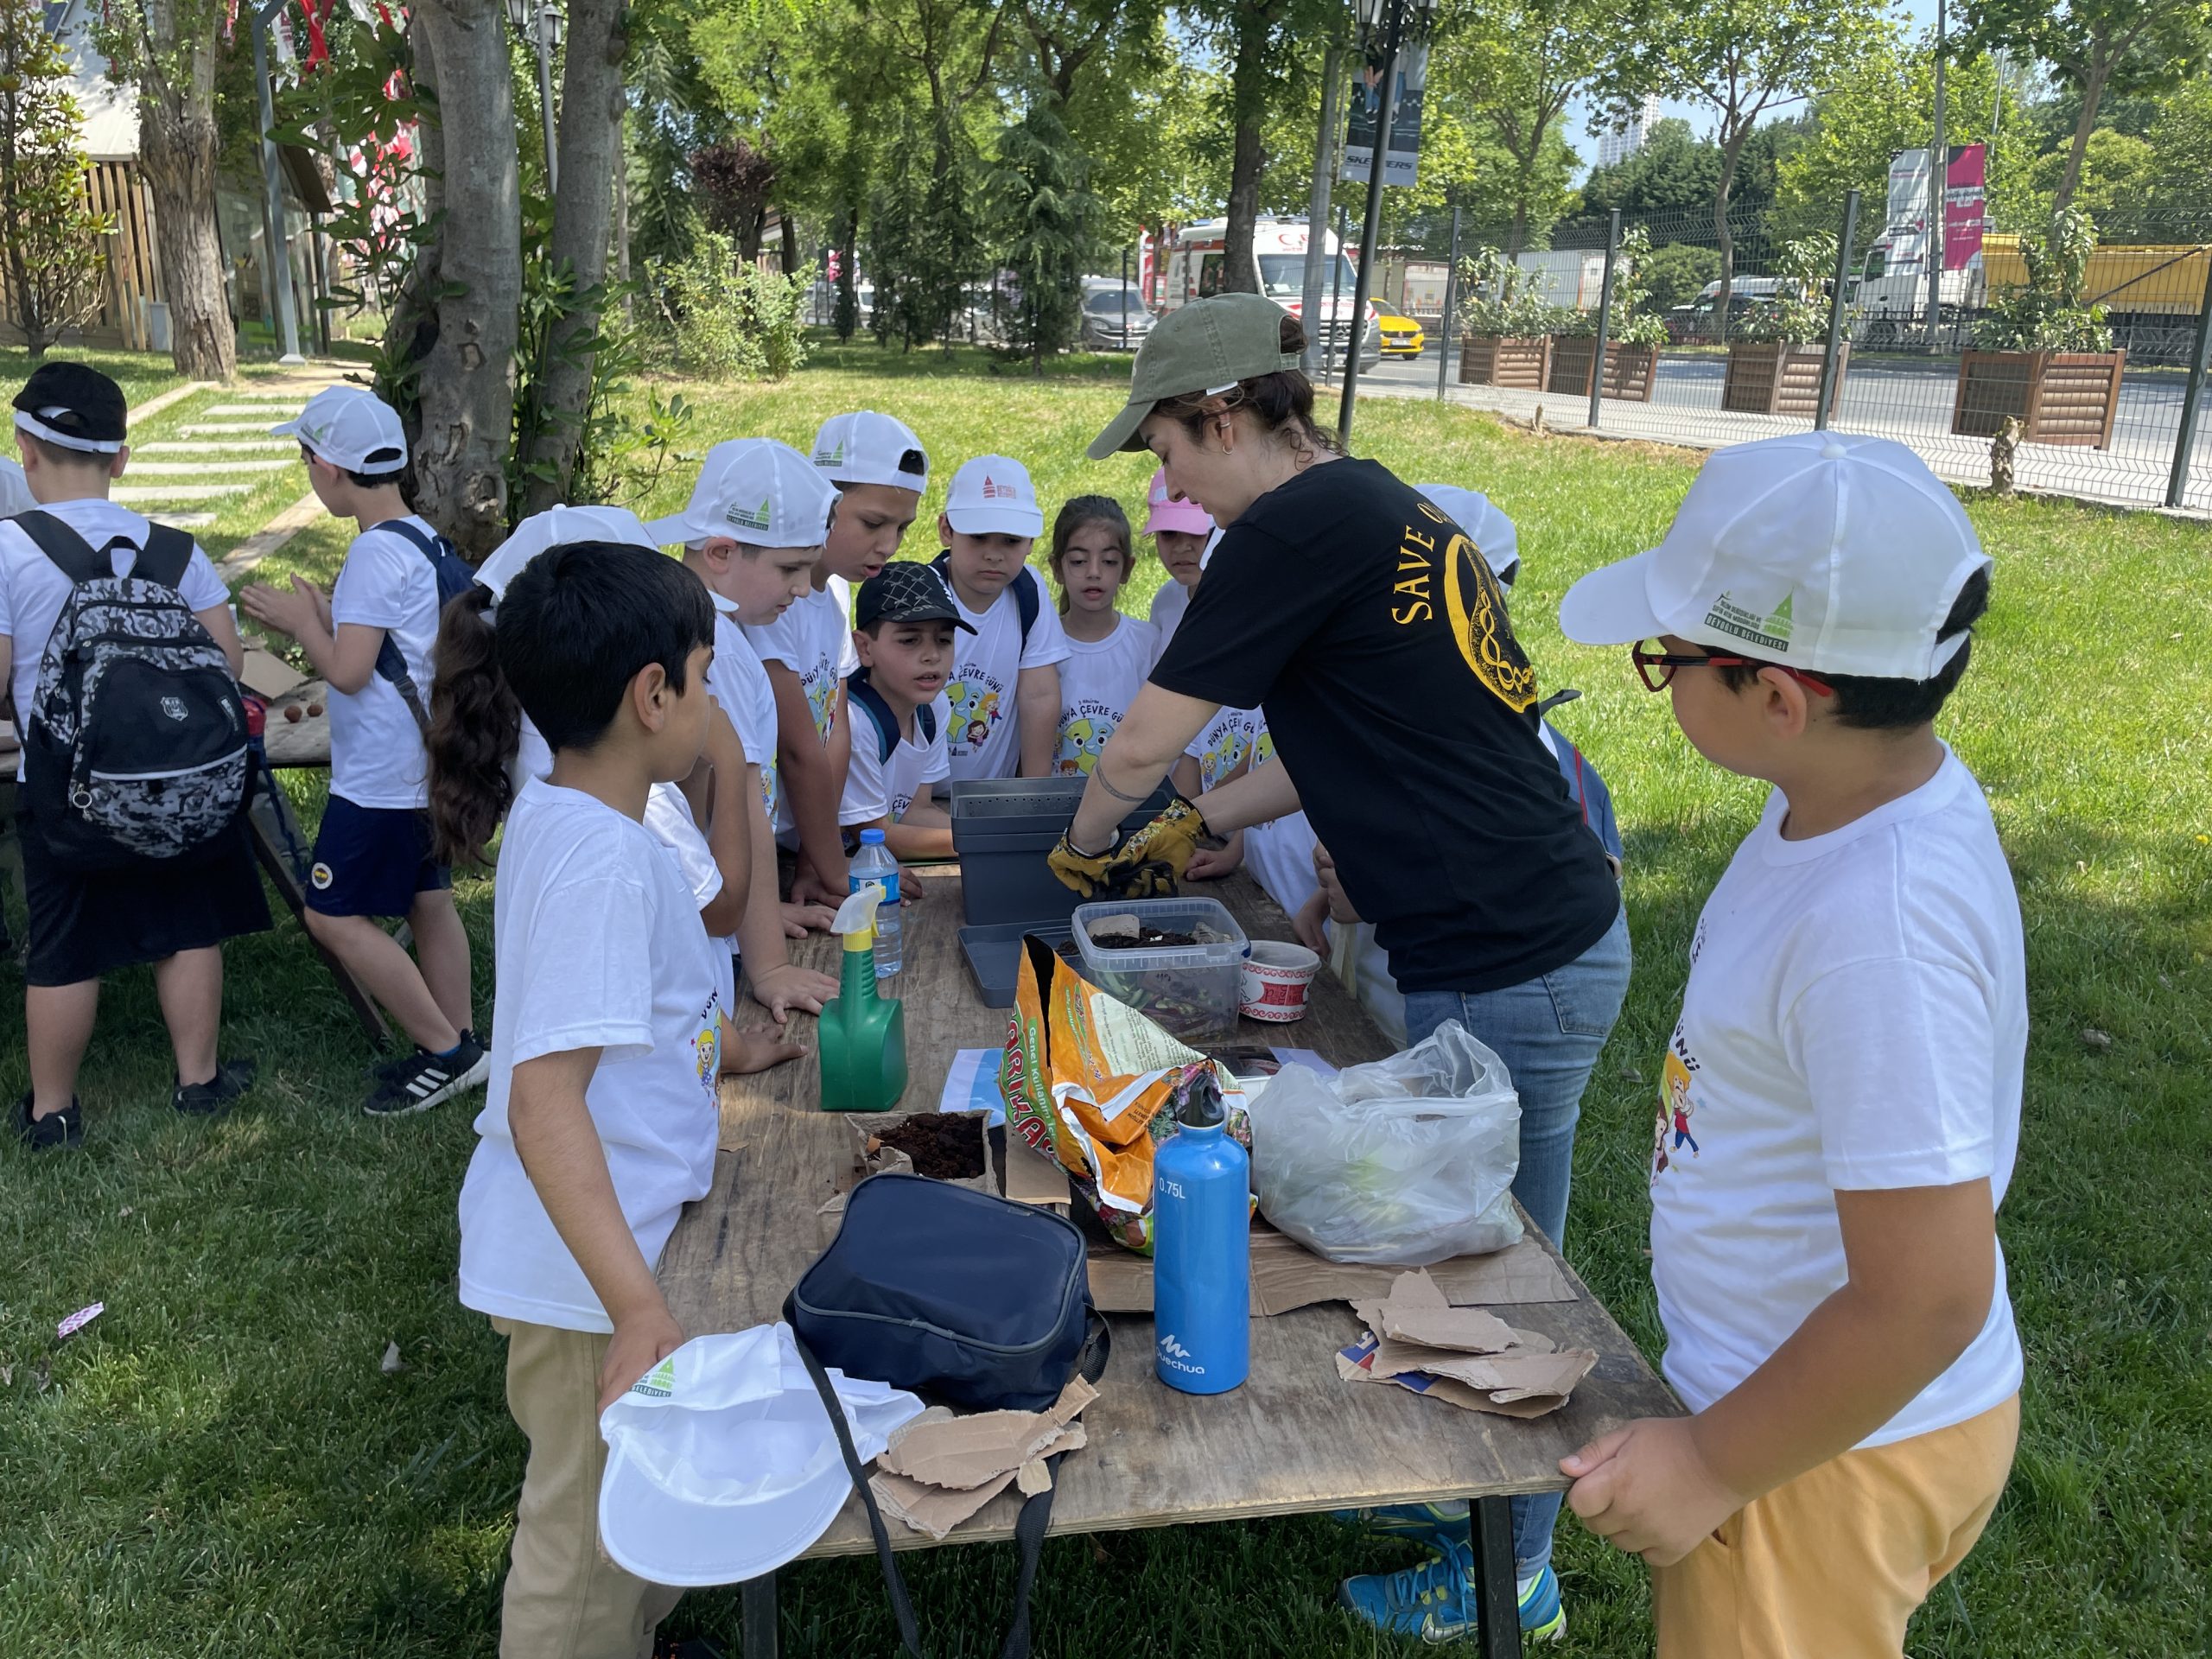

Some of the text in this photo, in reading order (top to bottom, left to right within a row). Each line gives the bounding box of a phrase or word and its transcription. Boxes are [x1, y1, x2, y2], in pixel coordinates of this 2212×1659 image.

[1345, 156, 1414, 170] SKEERS
[1392, 524, 1435, 624] SAVE
[892, 605, 942, 620] SPOR
[1079, 705, 1110, 718] ÇEVRE
[1111, 711, 1124, 722] GÜ
[892, 799, 910, 812] ÇEV
[1675, 1018, 1700, 1071] ÜNÜ
[1159, 1177, 1185, 1199] 0.75L
